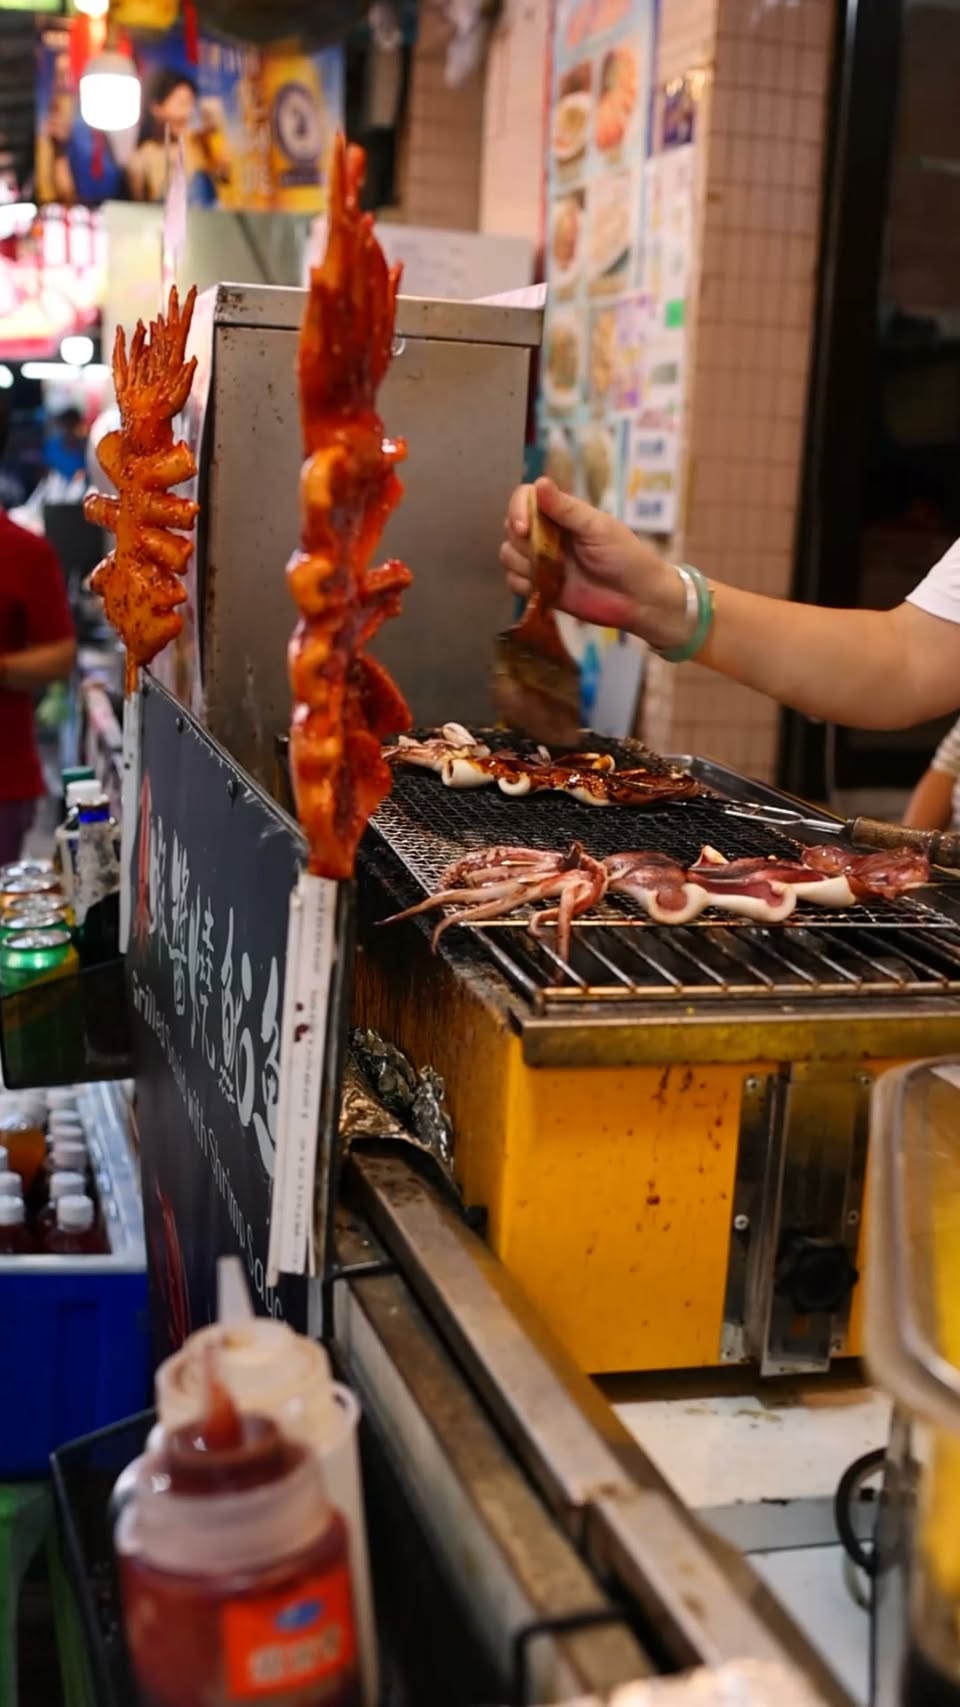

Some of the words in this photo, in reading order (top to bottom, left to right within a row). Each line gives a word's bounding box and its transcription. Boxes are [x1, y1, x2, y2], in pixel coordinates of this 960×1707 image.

[187, 1087, 208, 1157] with
[208, 1127, 246, 1250] Shrimp
[247, 1223, 286, 1321] Sauc
